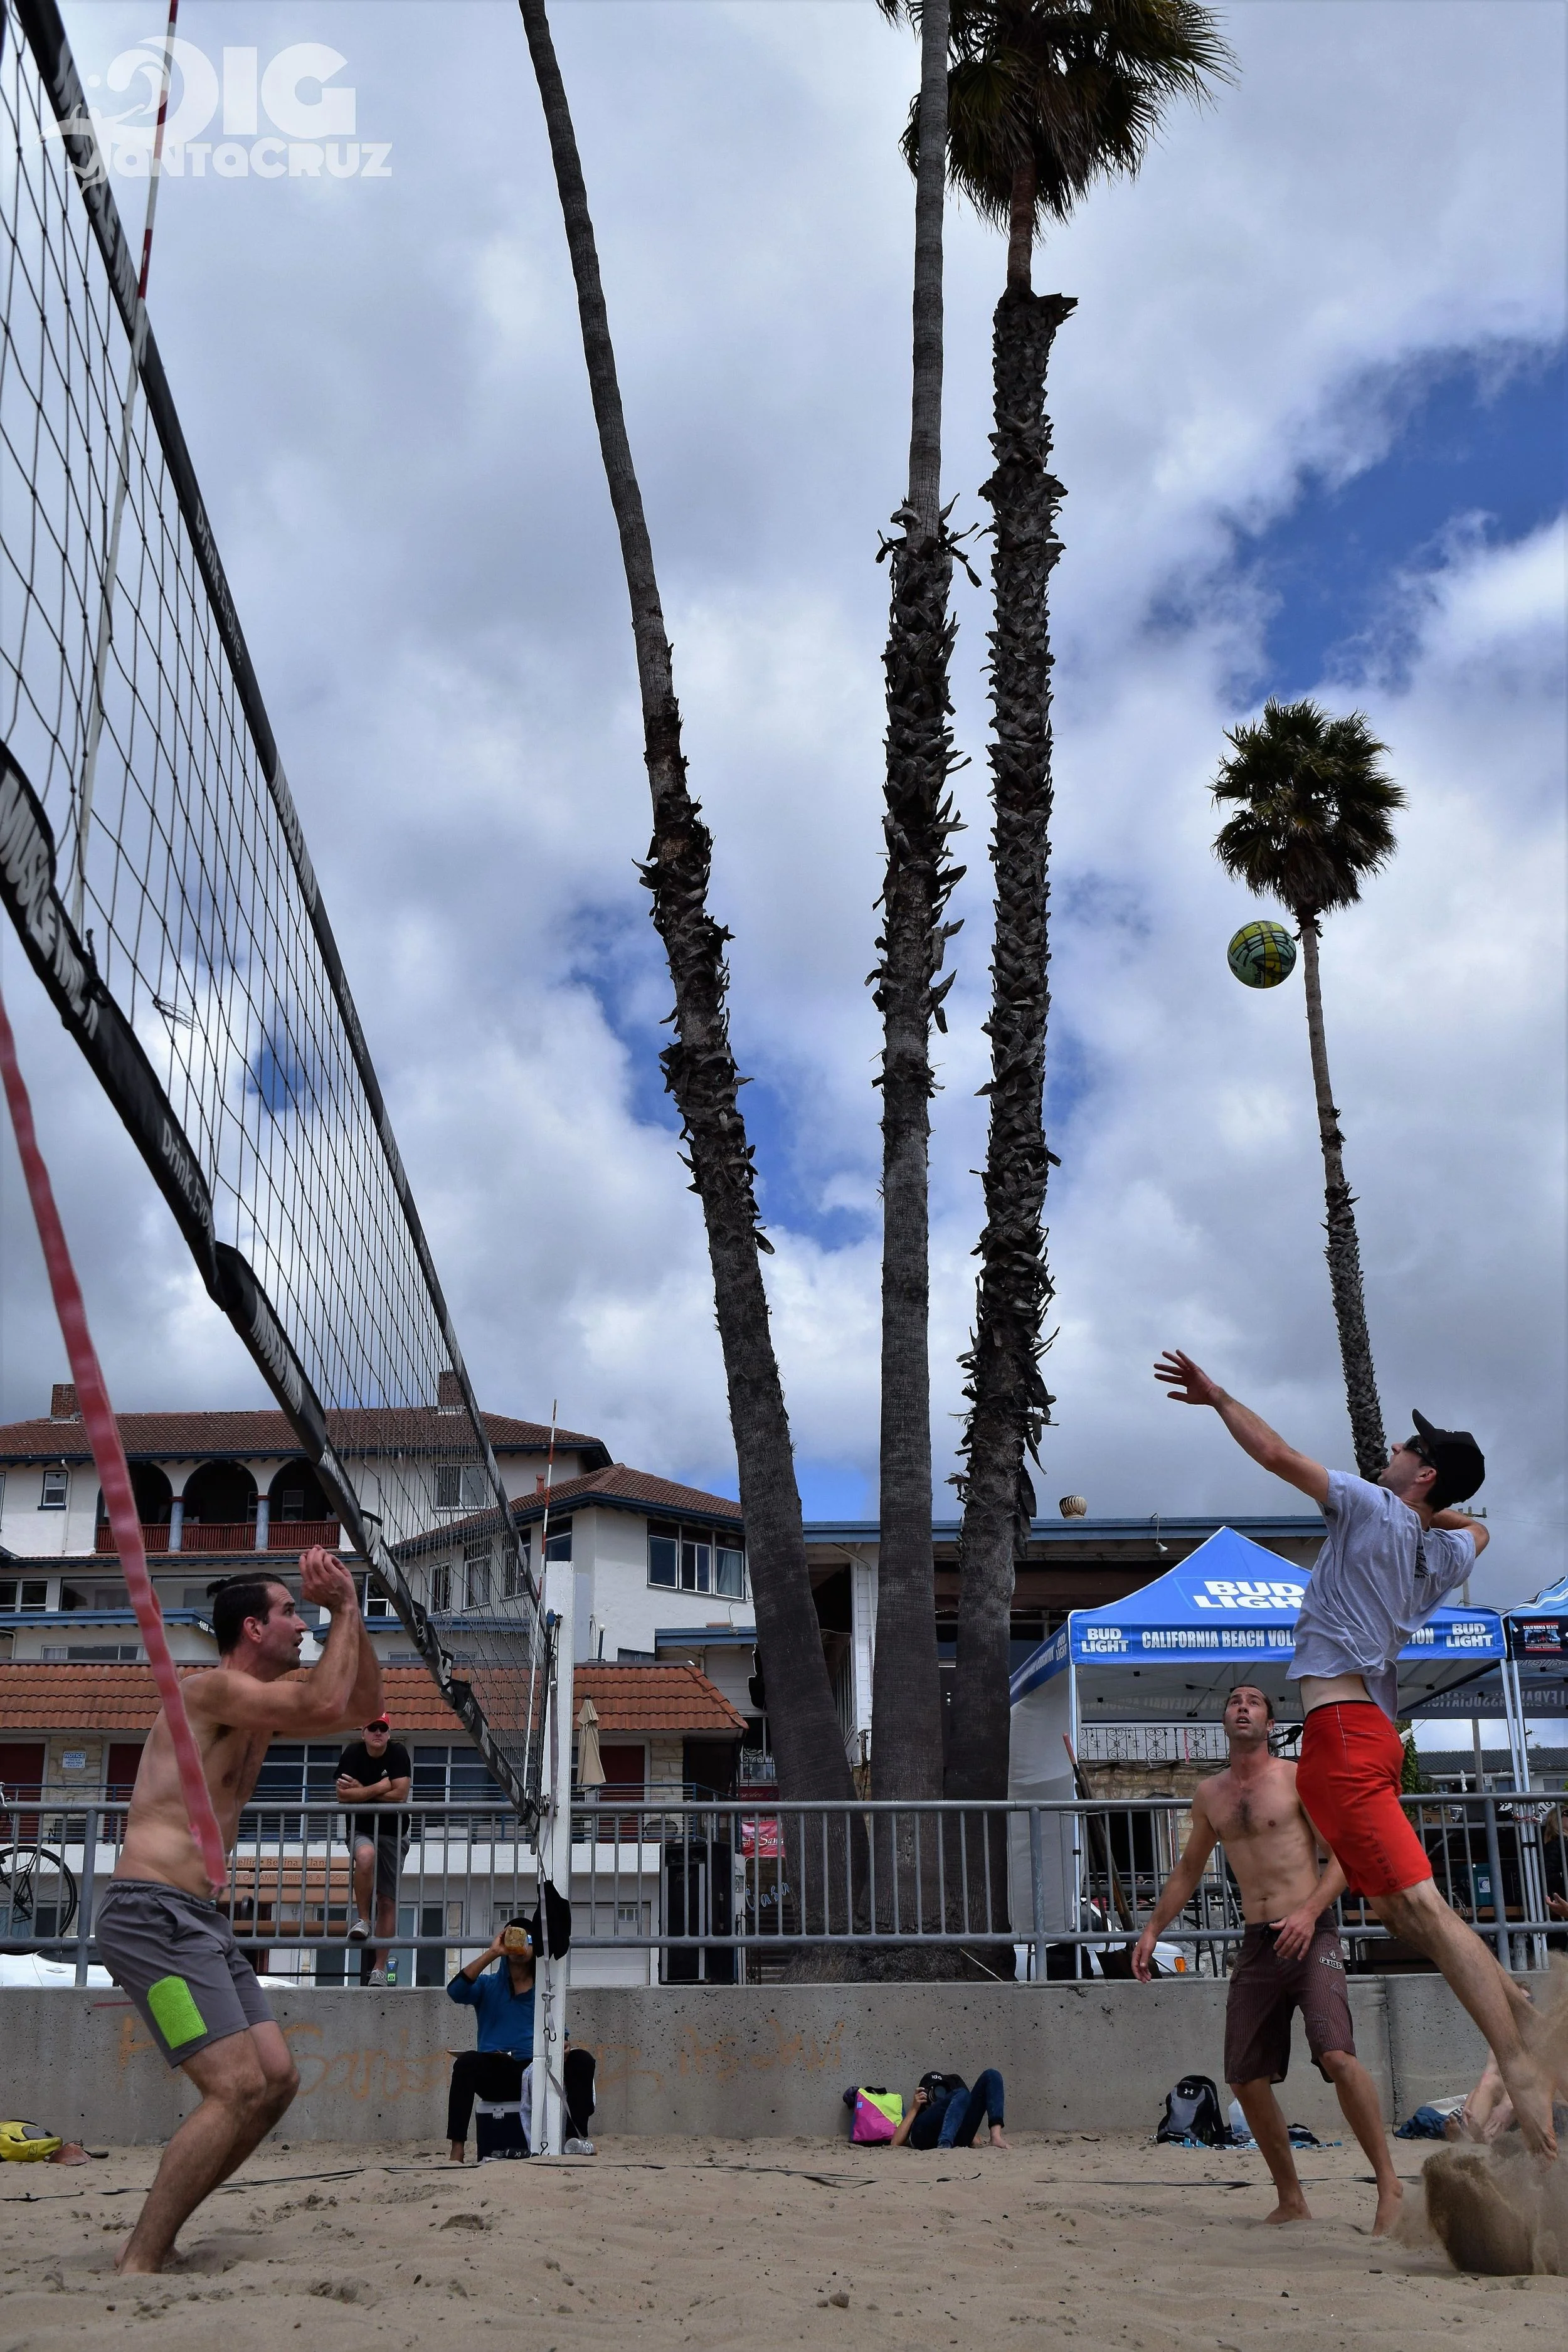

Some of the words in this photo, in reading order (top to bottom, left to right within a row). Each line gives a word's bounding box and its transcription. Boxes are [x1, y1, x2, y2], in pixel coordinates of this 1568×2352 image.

[1204, 1581, 1305, 1596] BUD
[1193, 1596, 1304, 1608] LIGH
[1087, 1628, 1122, 1640] BUD
[1451, 1623, 1486, 1635] BUD
[1142, 1631, 1219, 1648] CALIFORNIA
[1223, 1631, 1265, 1648] BEACH
[1446, 1634, 1493, 1648] LIGHT
[1081, 1640, 1129, 1653] LIGHT
